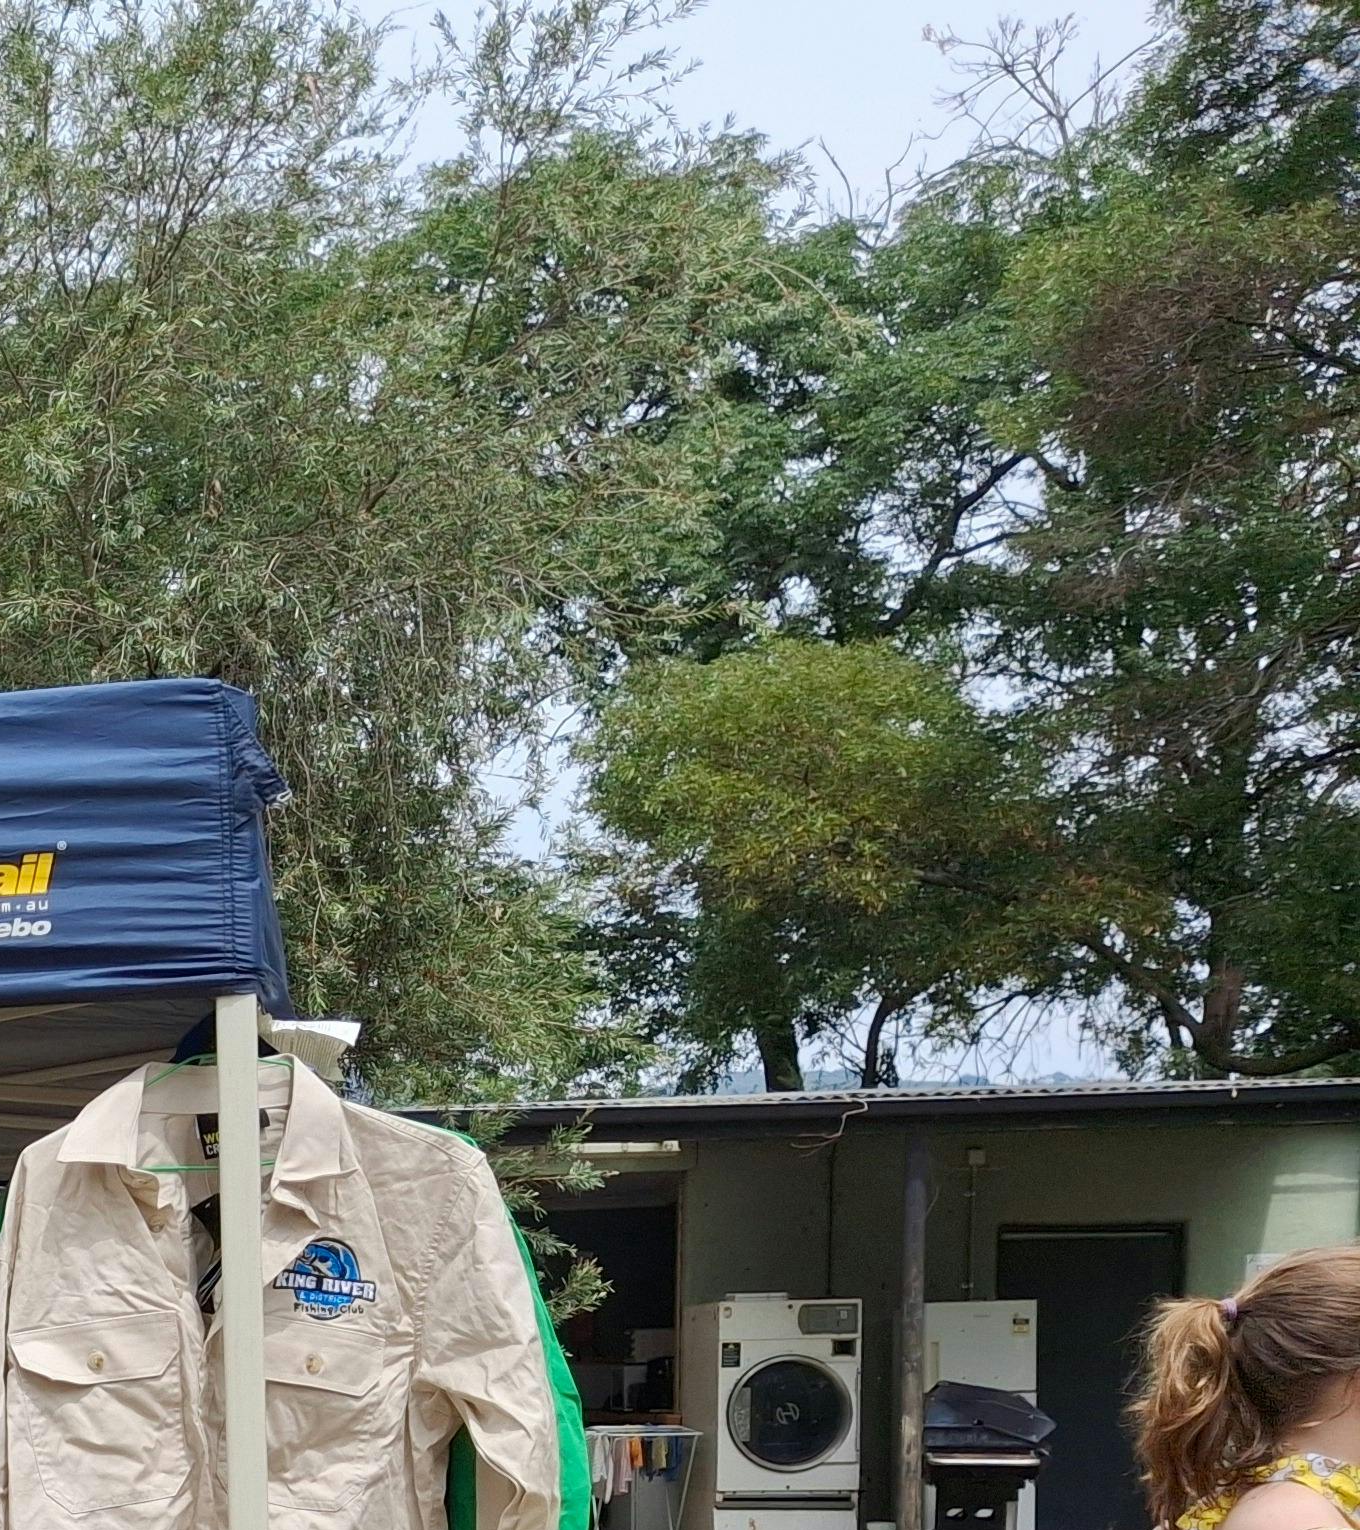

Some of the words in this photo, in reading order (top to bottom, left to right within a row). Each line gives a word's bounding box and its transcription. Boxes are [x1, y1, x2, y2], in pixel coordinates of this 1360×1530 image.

[275, 1272, 317, 1289] KING
[322, 1278, 375, 1300] RIVER
[310, 1293, 348, 1303] DISTRICT
[293, 1303, 334, 1315] Fishing
[340, 1305, 364, 1315] Club
